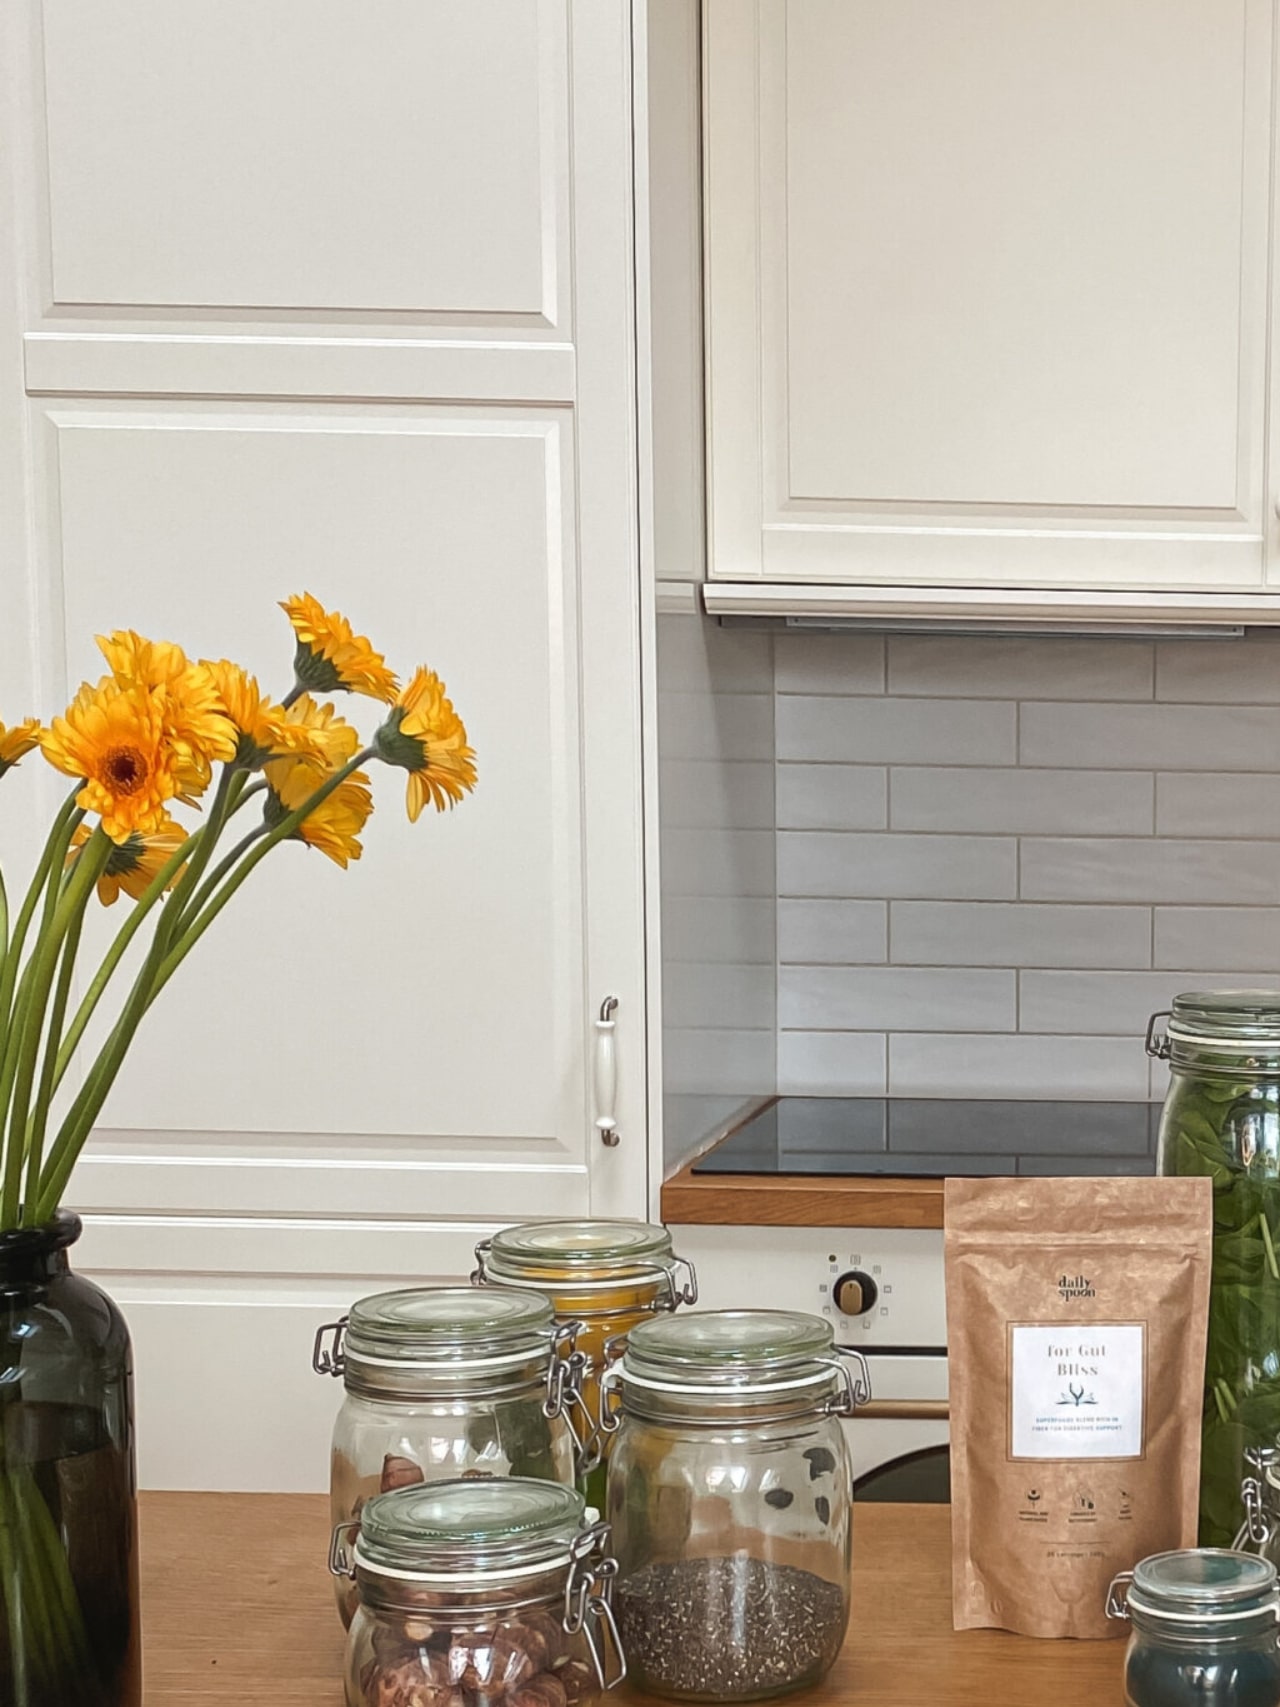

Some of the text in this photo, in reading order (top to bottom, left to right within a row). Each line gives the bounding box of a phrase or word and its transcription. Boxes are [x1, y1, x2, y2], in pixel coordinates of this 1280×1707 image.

[1059, 1275, 1090, 1290] daily
[1059, 1289, 1096, 1302] spoon
[1058, 1363, 1098, 1376] Bliss
